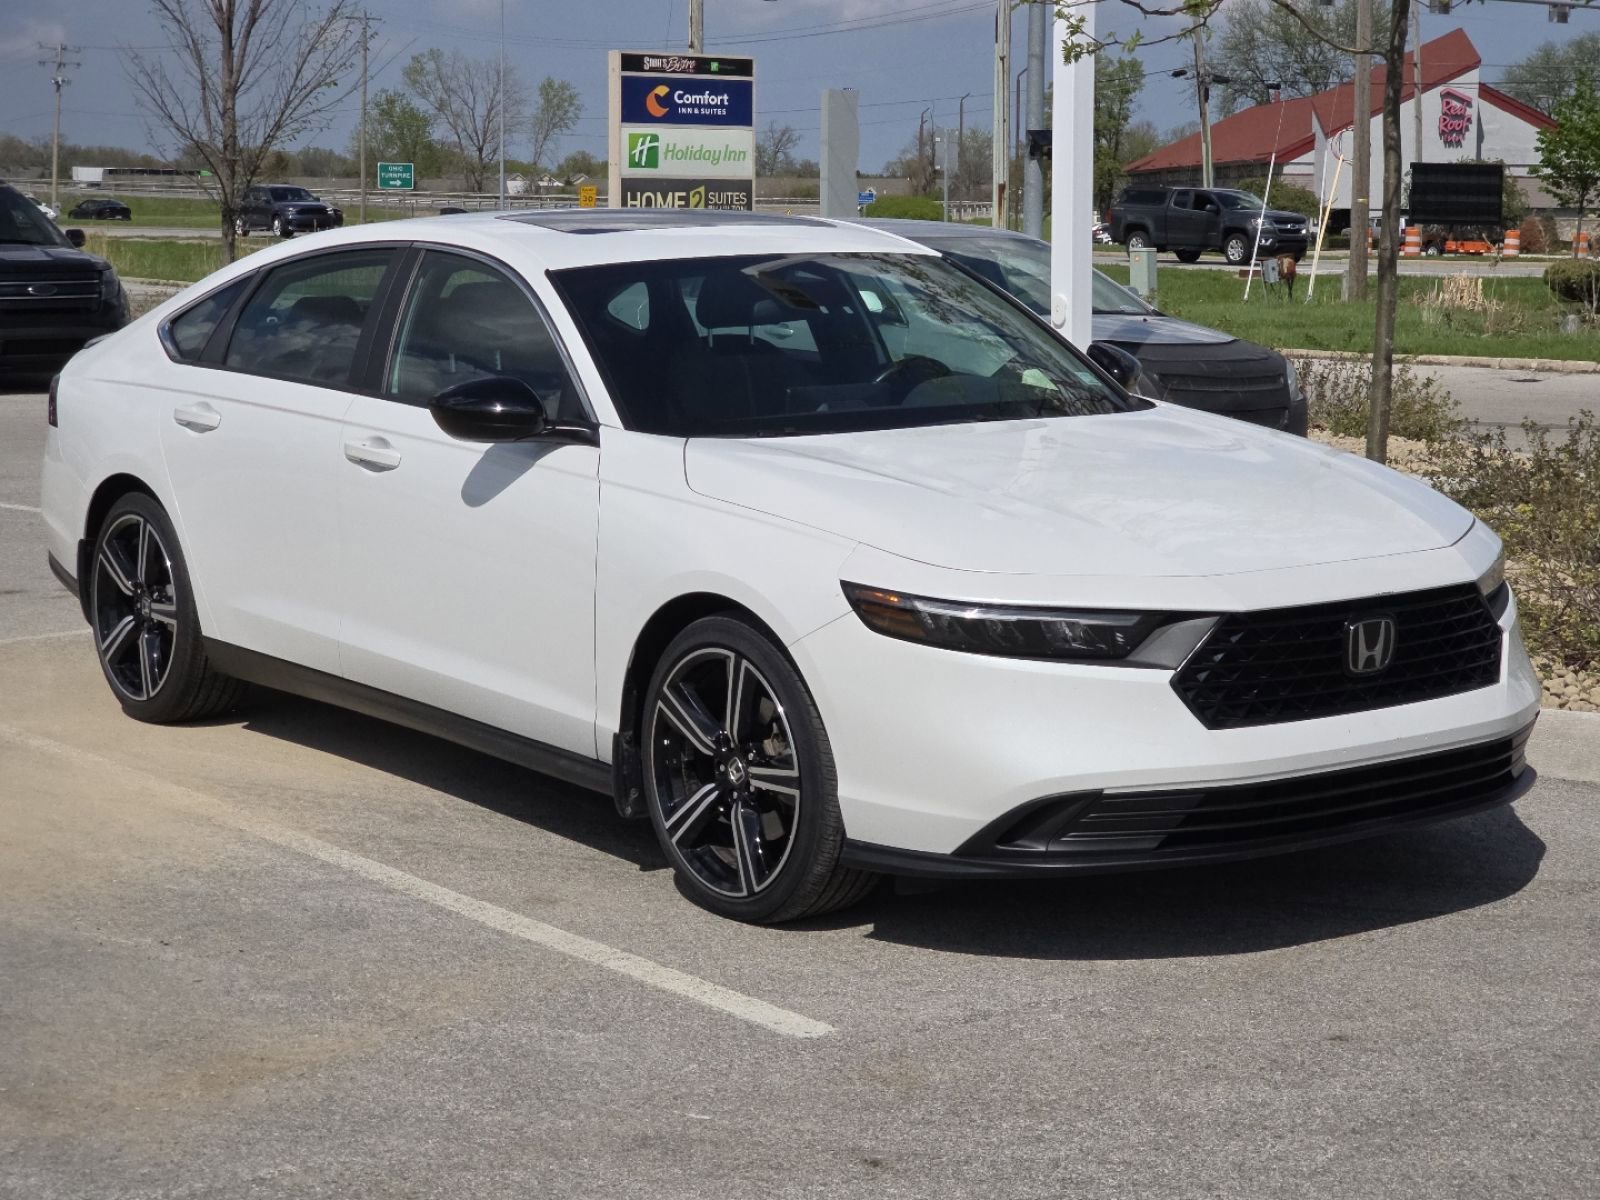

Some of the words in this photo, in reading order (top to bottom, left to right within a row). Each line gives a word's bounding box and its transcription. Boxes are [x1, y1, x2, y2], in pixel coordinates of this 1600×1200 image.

[674, 90, 729, 105] Comfort
[701, 107, 727, 115] SUITES
[1442, 99, 1467, 115] Red
[1440, 115, 1472, 133] Roof
[664, 143, 721, 166] Holiday
[723, 144, 747, 161] Inn
[627, 191, 687, 208] HOME
[708, 192, 747, 205] SUITES
